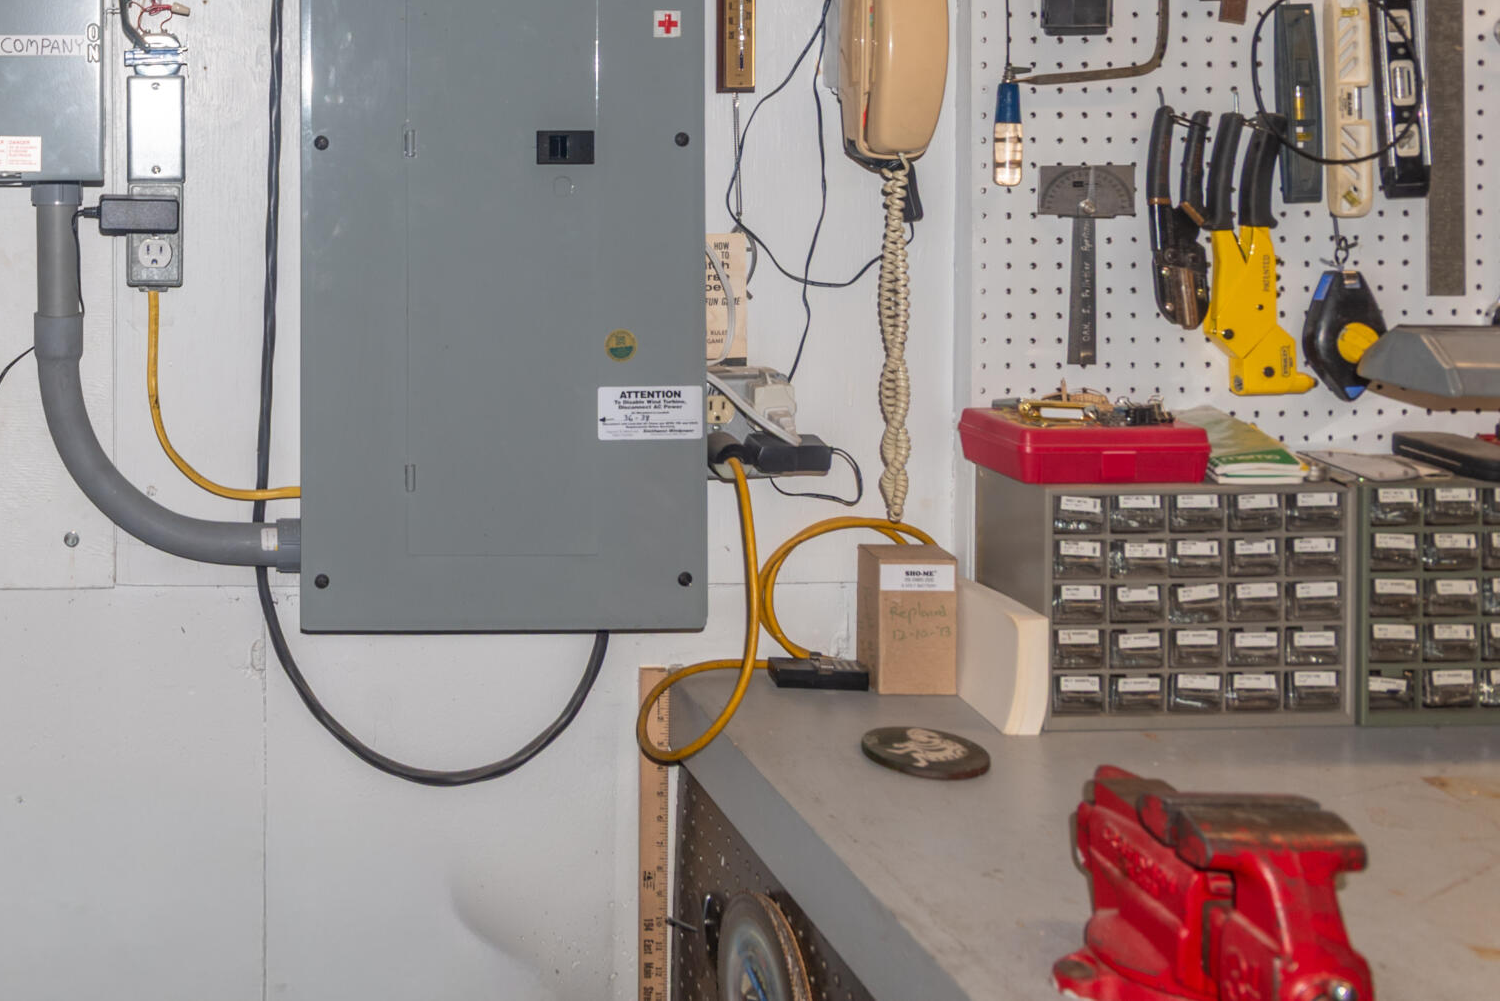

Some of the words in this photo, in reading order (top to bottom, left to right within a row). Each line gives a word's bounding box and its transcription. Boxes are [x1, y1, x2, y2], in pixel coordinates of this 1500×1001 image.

[1, 37, 84, 54] COMPANY
[87, 23, 101, 63] ON
[714, 242, 729, 250] HOW
[721, 251, 729, 259] TO
[620, 390, 681, 399] ATTENTION
[643, 939, 654, 954] East
[643, 962, 654, 979] Main
